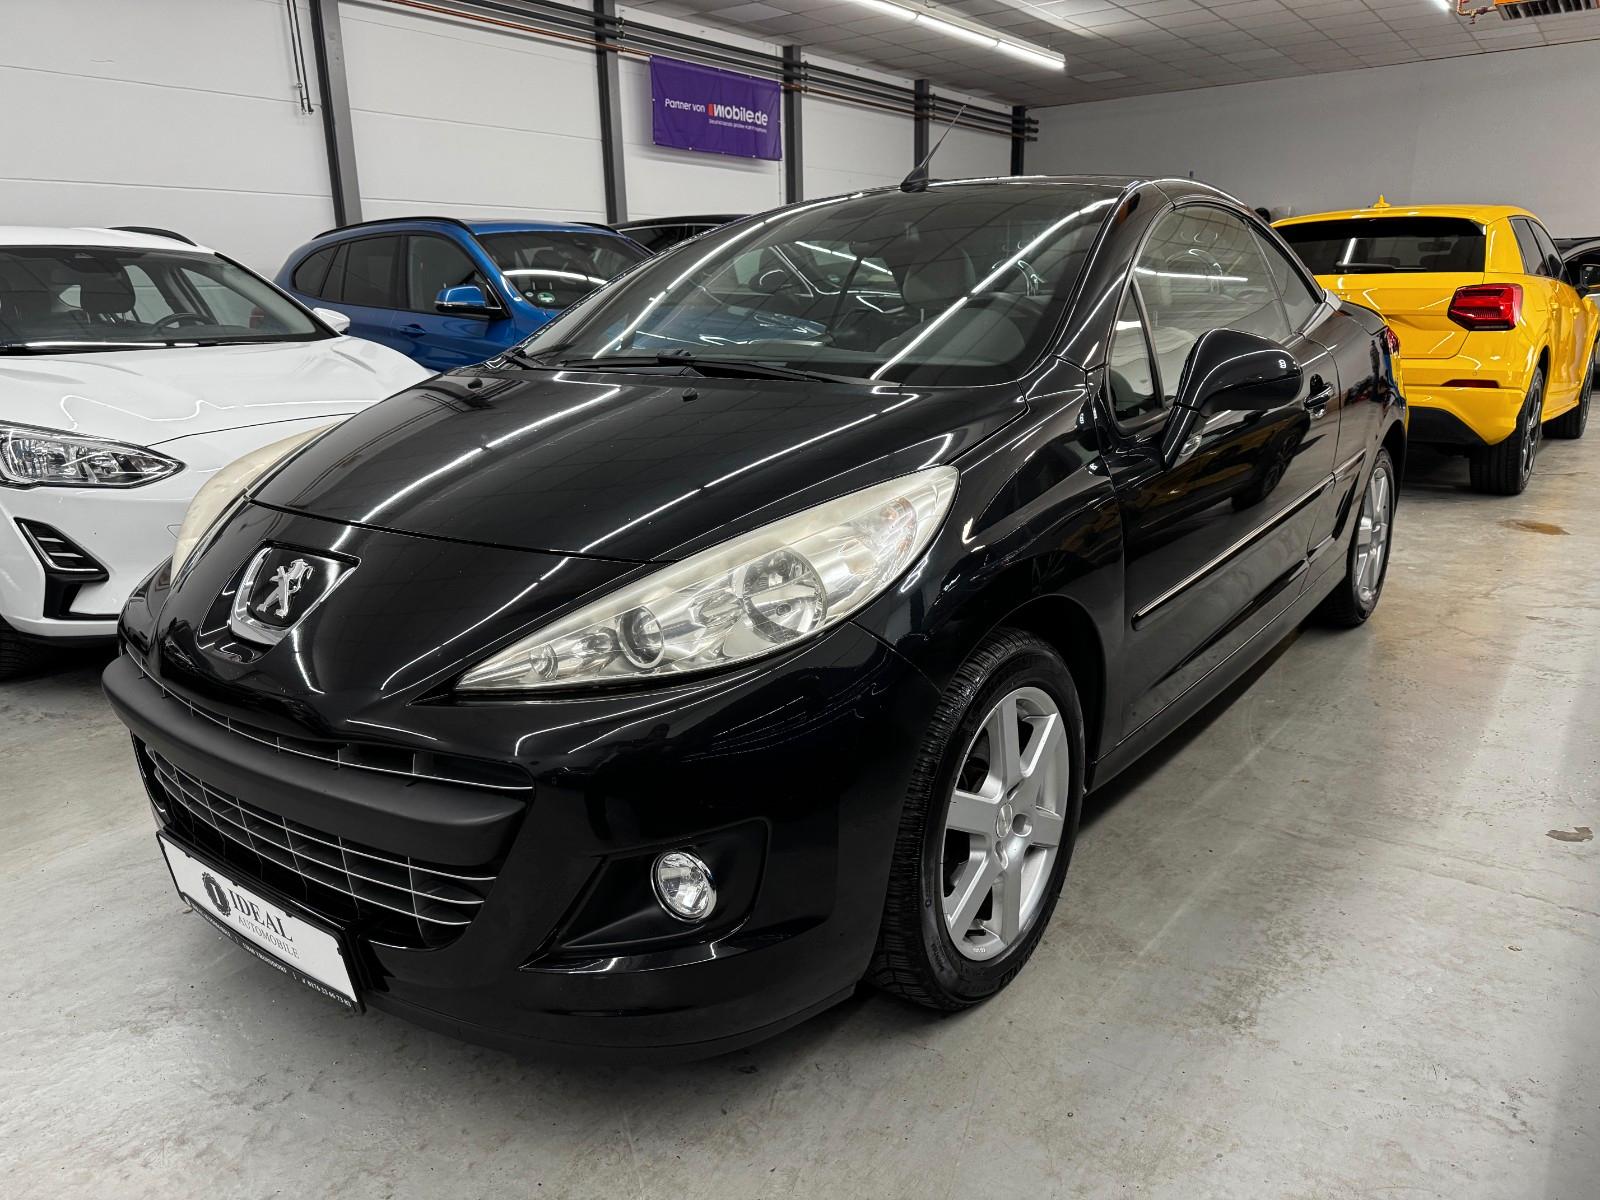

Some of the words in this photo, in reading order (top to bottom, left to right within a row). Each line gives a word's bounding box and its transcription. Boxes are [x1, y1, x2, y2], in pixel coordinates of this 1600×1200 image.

[664, 98, 692, 111] Partner
[692, 103, 706, 113] von
[226, 887, 294, 943] IDEAL
[238, 915, 300, 960] AUTOMOBILE
